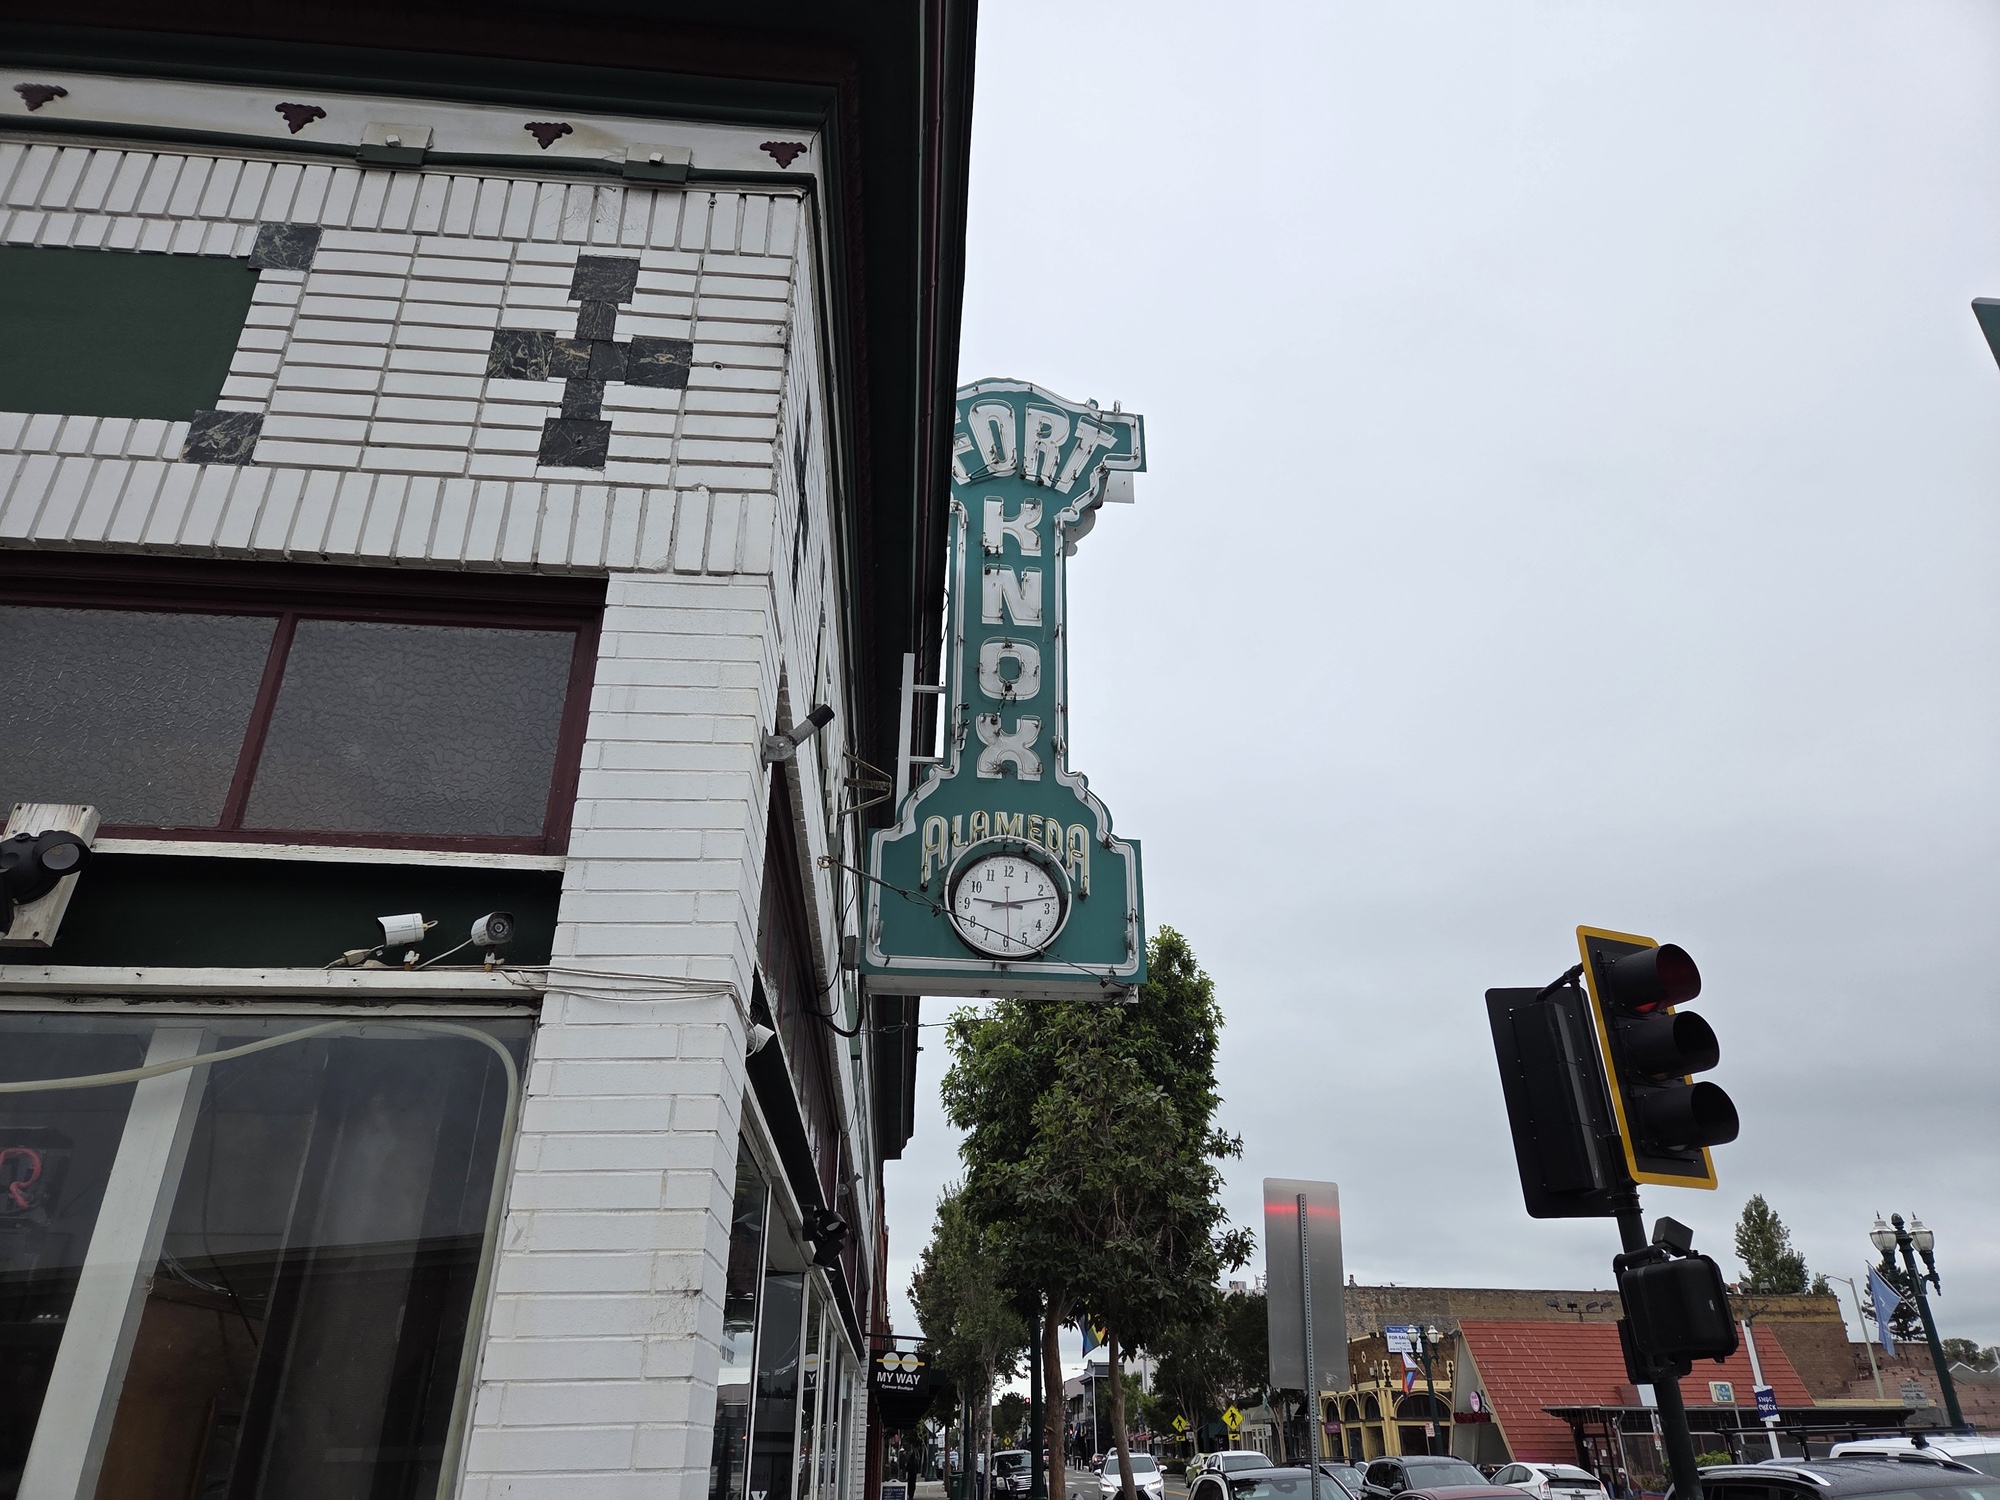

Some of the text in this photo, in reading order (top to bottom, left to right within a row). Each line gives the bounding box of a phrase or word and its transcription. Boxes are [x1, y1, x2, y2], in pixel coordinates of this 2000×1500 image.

[976, 496, 1044, 781] KNOX
[920, 810, 1090, 896] ALAMEDA
[986, 869, 995, 882] 11
[1003, 865, 1014, 878] 12
[1024, 871, 1029, 883] 1
[971, 880, 983, 893] 10
[1037, 884, 1044, 897] 2
[964, 896, 971, 910] 9
[1044, 902, 1051, 915] 3
[969, 915, 976, 928] 8
[1035, 919, 1042, 932] 4
[983, 928, 990, 941] 7
[1021, 932, 1028, 945] 5
[1002, 936, 1009, 948] 6
[876, 1371, 921, 1385] MY WAY
